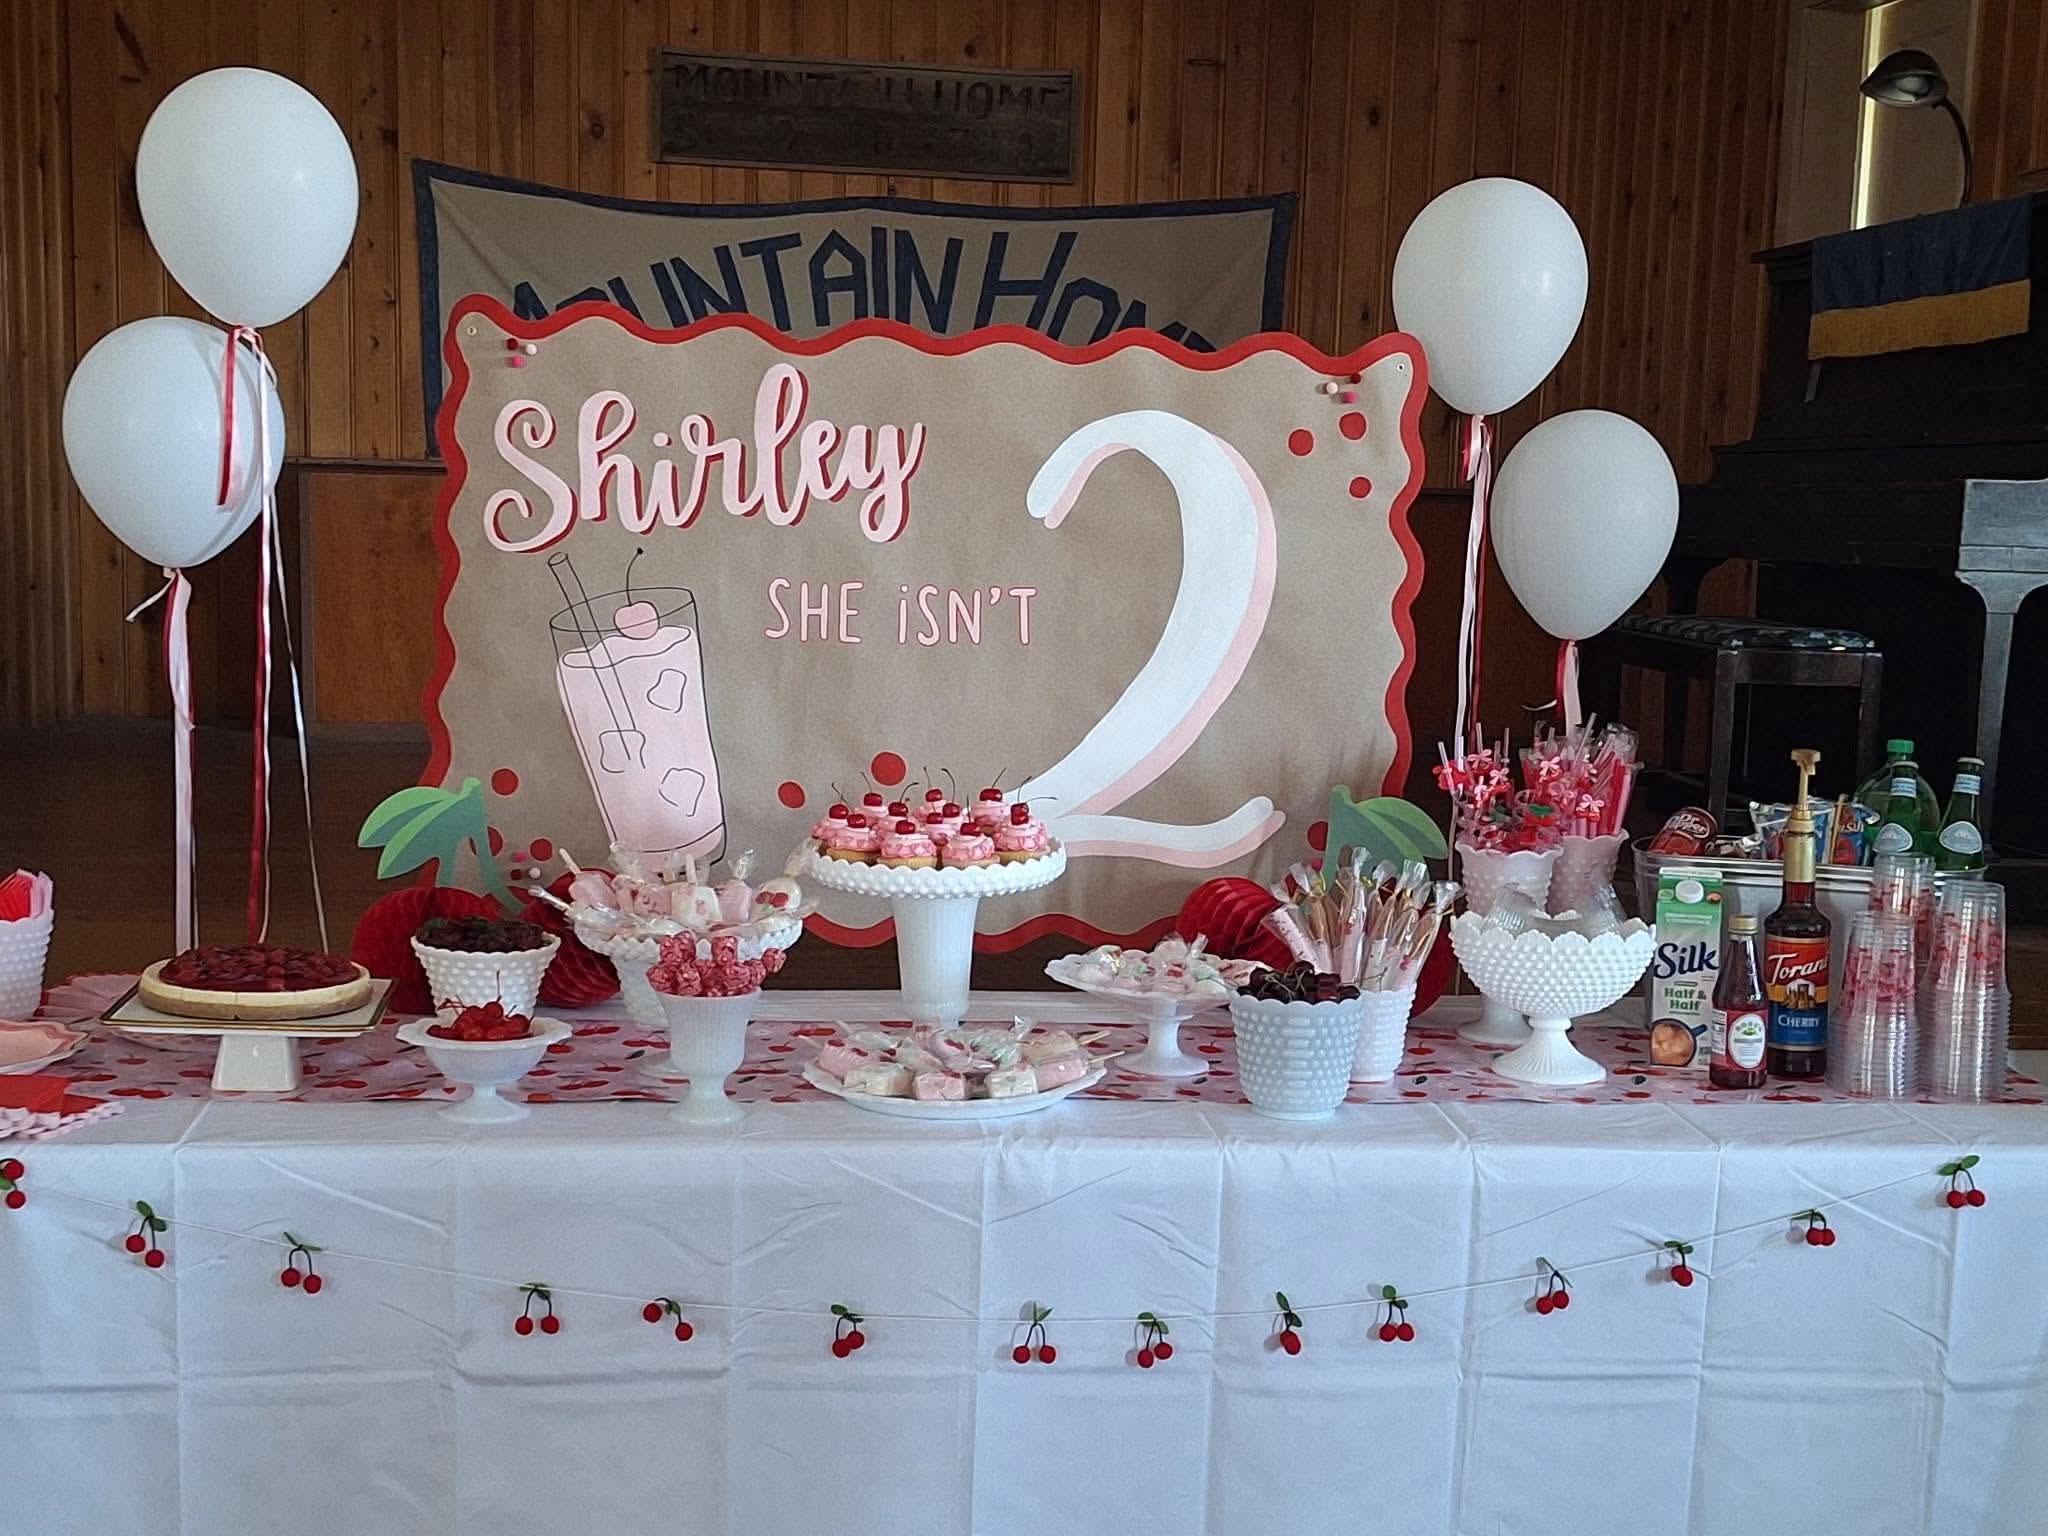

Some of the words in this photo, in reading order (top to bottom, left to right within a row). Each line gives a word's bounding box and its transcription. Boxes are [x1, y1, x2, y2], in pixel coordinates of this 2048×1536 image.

[513, 226, 945, 333] UNTAIN
[974, 231, 1216, 353] HO
[484, 363, 926, 553] Shirley
[764, 578, 863, 645] SHE
[1002, 409, 1286, 869] 2
[1654, 941, 1720, 980] Silk
[1664, 988, 1695, 999] Half
[1697, 990, 1707, 1000] &
[1670, 1000, 1701, 1011] Half
